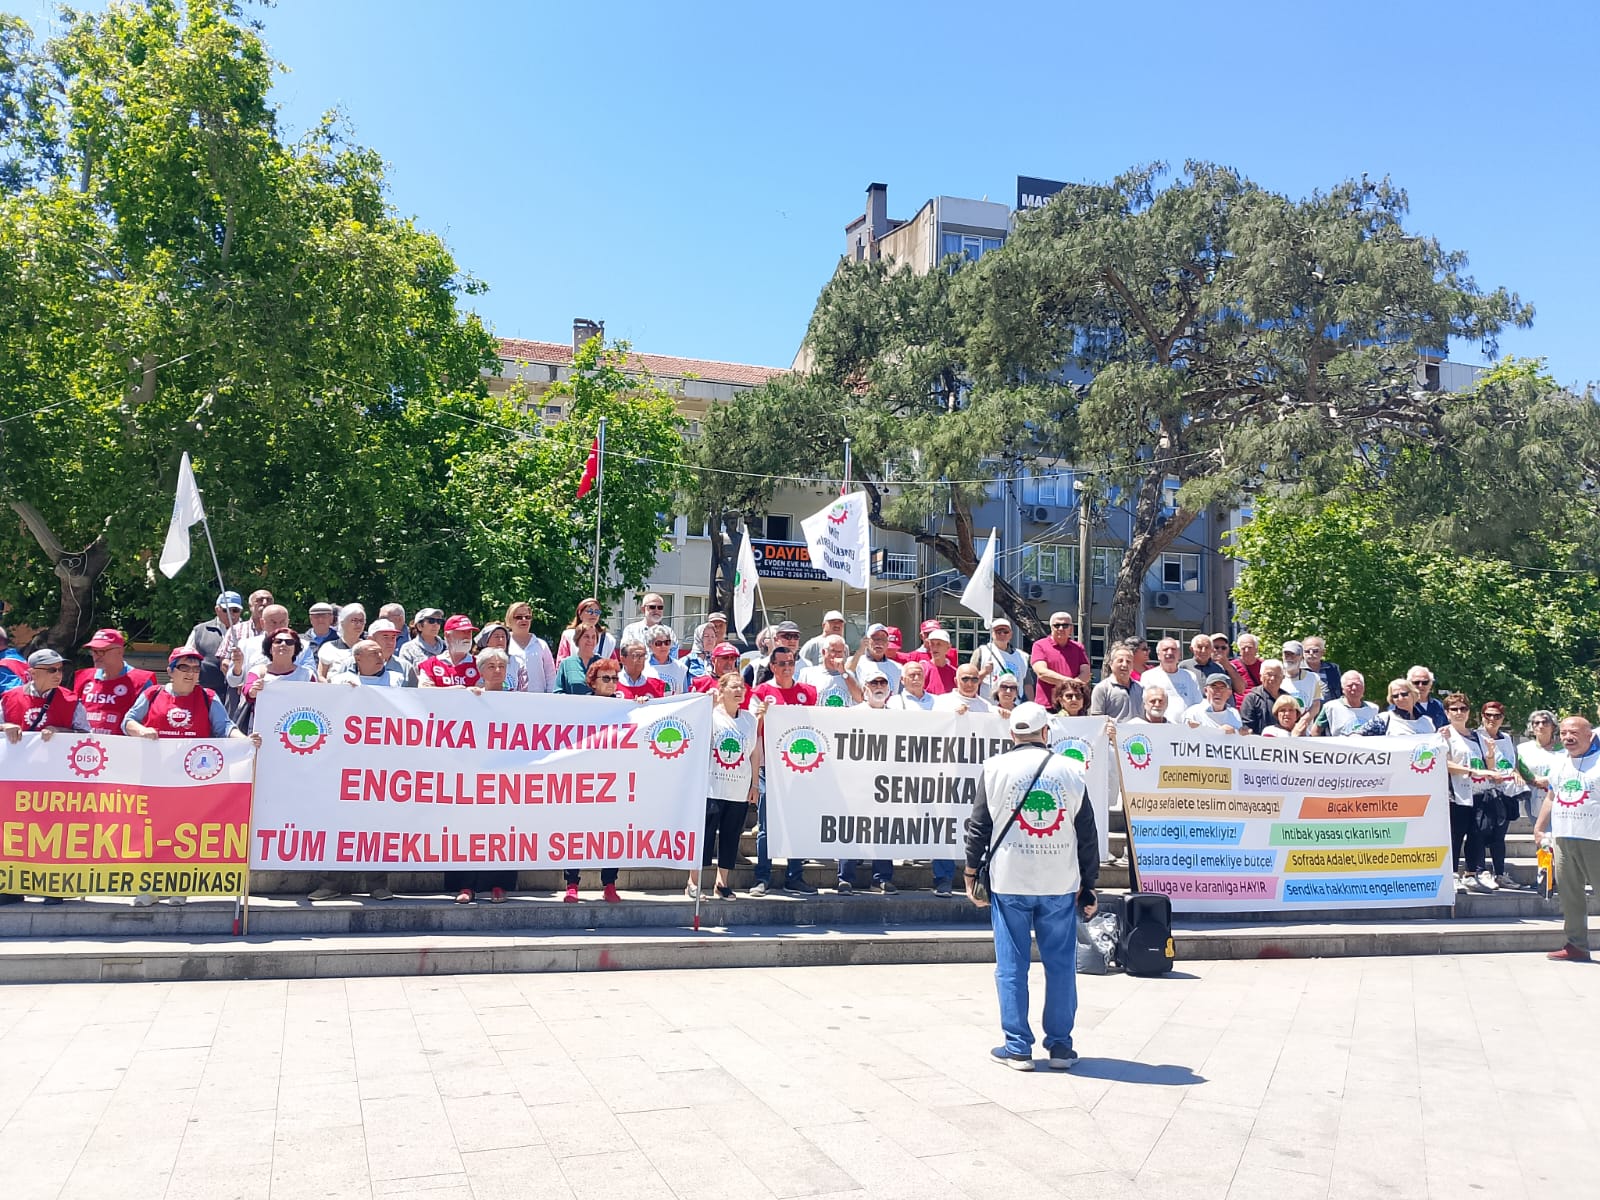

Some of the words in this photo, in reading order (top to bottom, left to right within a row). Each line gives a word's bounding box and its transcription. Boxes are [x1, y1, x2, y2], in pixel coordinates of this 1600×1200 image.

[1021, 193, 1049, 208] MAS
[765, 545, 811, 561] DAYIB
[85, 690, 118, 704] DİSK
[343, 712, 477, 749] SENDİKA
[487, 721, 638, 750] HAKKIMIZ
[834, 728, 888, 762] TÜM
[895, 732, 1015, 764] EMEKLİLER
[1170, 739, 1200, 757] TÜM
[1205, 743, 1299, 764] EMEKLİLERİN
[339, 768, 617, 805] ENGELLENEMEZ
[874, 772, 977, 804] SENDİKA
[15, 789, 149, 814] BURHANİYE
[1197, 798, 1227, 811] teslim
[4, 818, 248, 859] EMEKLİ-SEN
[820, 812, 957, 844] BURHANİYE
[257, 823, 327, 862] TÜM
[336, 826, 538, 862] EMEKLİLERİN
[548, 823, 696, 862] SENDİKASI
[1137, 853, 1170, 867] daşlara
[1292, 853, 1325, 866] Sofrada
[1391, 850, 1438, 863] Demokrasi
[20, 868, 134, 893] EMEKLİLER
[139, 867, 242, 893] SENDİKASI
[1180, 882, 1193, 893] ve
[1239, 881, 1267, 893] HAYIR
